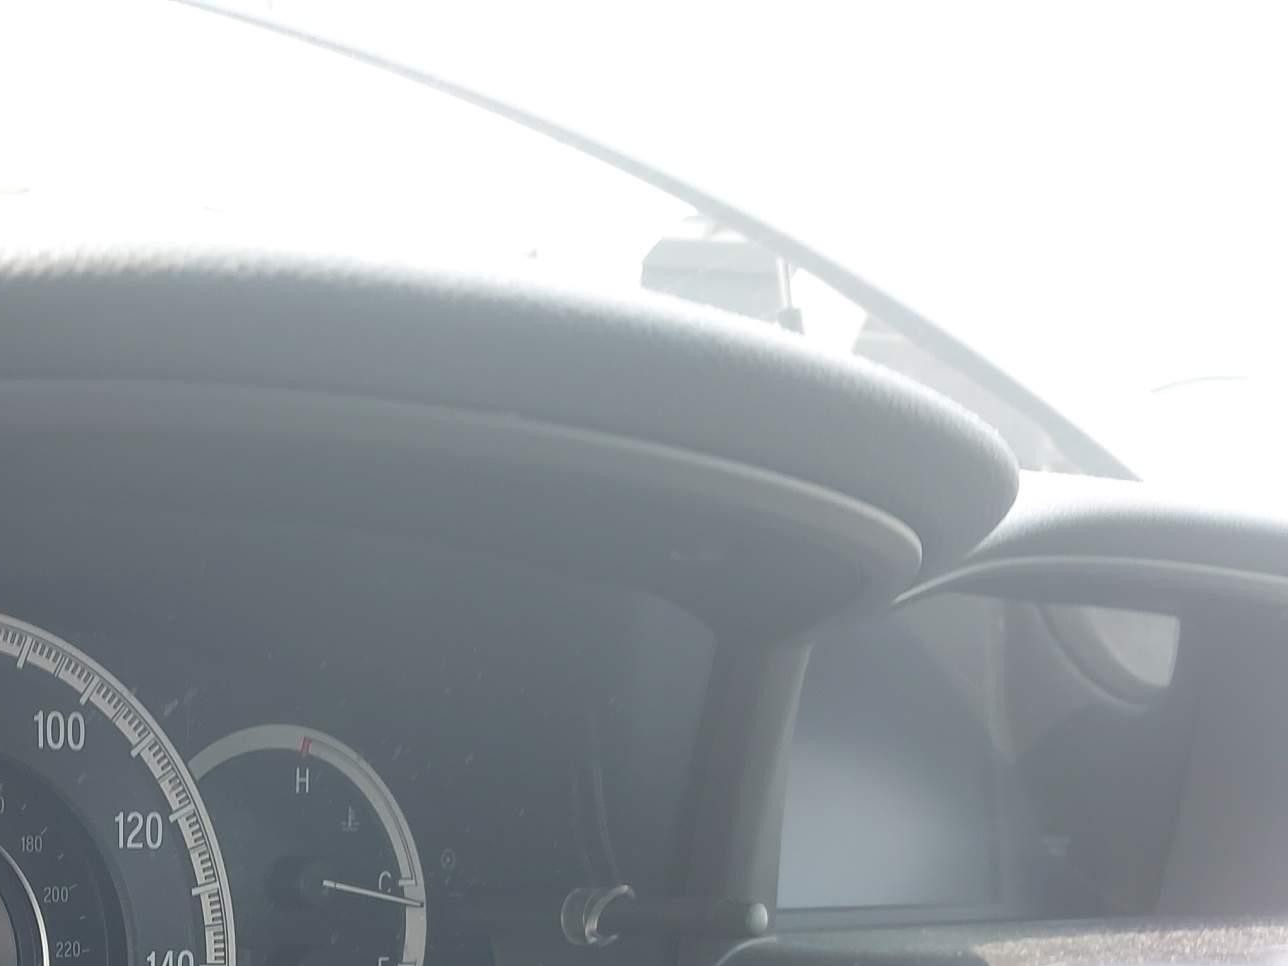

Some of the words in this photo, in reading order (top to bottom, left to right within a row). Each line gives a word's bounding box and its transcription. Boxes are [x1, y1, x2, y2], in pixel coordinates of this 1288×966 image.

[33, 710, 85, 751] 100
[295, 768, 309, 794] H
[114, 811, 163, 849] 120
[21, 835, 43, 853] 180
[378, 870, 392, 893] C
[43, 885, 69, 903] 200
[55, 940, 81, 958] 220
